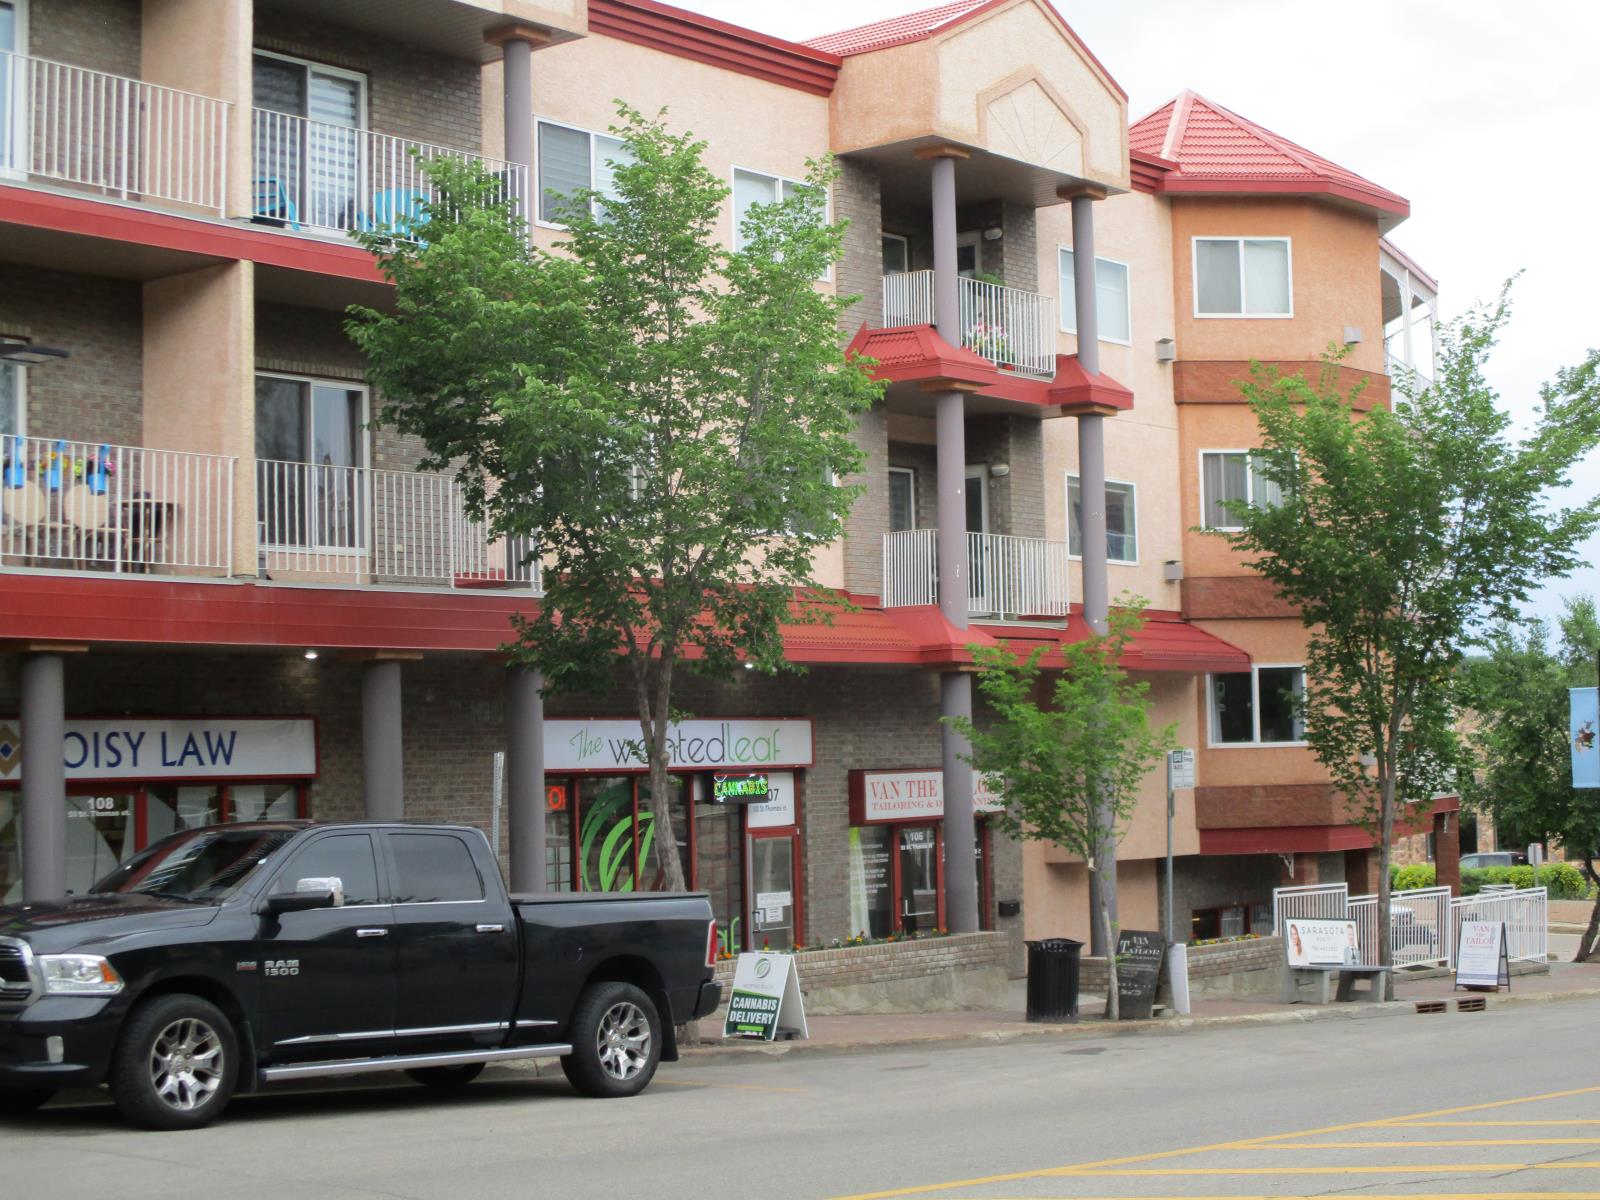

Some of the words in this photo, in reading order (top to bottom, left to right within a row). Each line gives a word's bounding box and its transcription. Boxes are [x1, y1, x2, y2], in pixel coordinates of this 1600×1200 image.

[161, 730, 237, 767] LAW
[570, 728, 603, 761] The
[713, 780, 768, 797] CANNABIS
[870, 780, 900, 800] VAN
[905, 779, 938, 798] THE
[768, 789, 779, 801] 07
[87, 797, 114, 810] 108
[872, 801, 924, 811] TAILORING
[910, 832, 924, 841] 106
[1301, 926, 1345, 935] SARASOTA
[1473, 925, 1491, 933] VAN
[1465, 937, 1496, 945] TAILOR
[264, 960, 300, 968] RAM
[264, 968, 300, 976] 1500
[732, 997, 778, 1011] CANNABIS
[729, 1010, 775, 1025] DELIVERY
